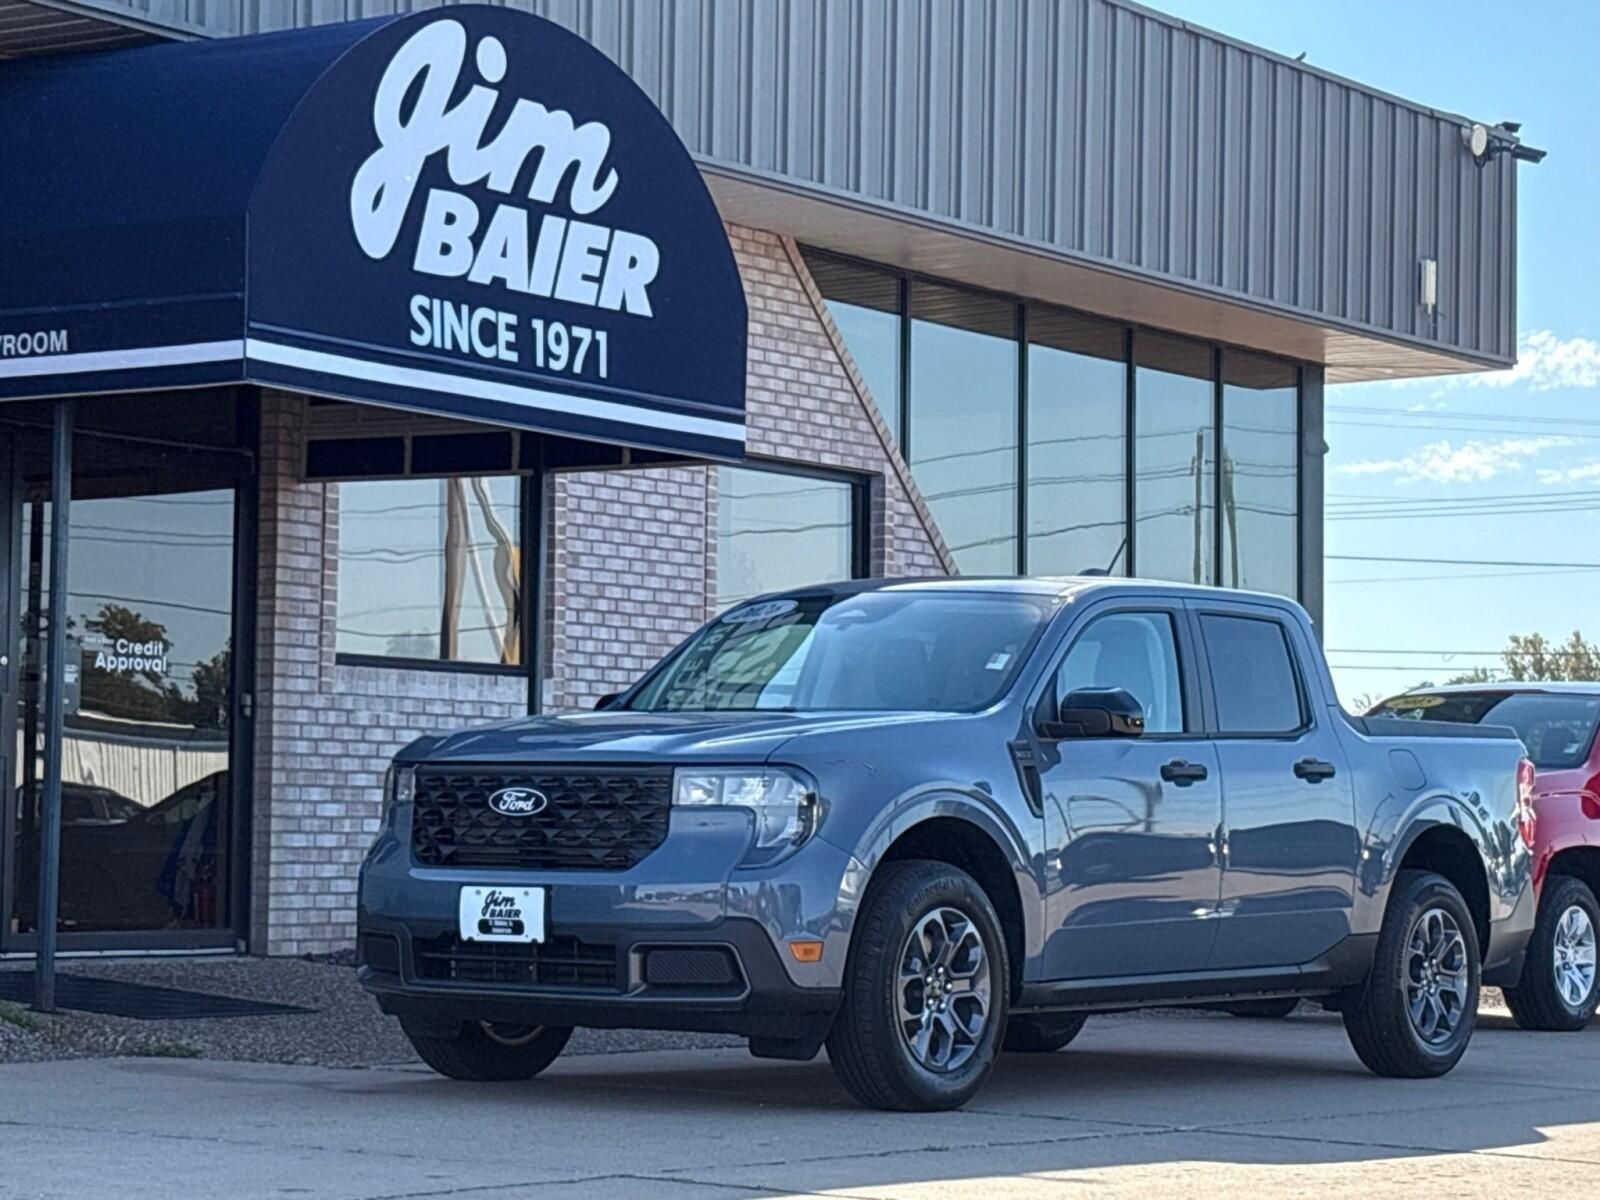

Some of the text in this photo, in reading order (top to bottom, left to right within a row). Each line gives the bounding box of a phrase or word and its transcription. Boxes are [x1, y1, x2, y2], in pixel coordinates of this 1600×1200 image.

[350, 18, 619, 260] Jim
[412, 187, 660, 318] BAIER
[0, 329, 68, 356] ROOM
[409, 294, 608, 379] SINCE 1971
[116, 638, 164, 656] Credit
[94, 651, 167, 673] Approval
[499, 791, 536, 812] Ford
[481, 889, 516, 917] Jim
[489, 908, 522, 918] BAIER
